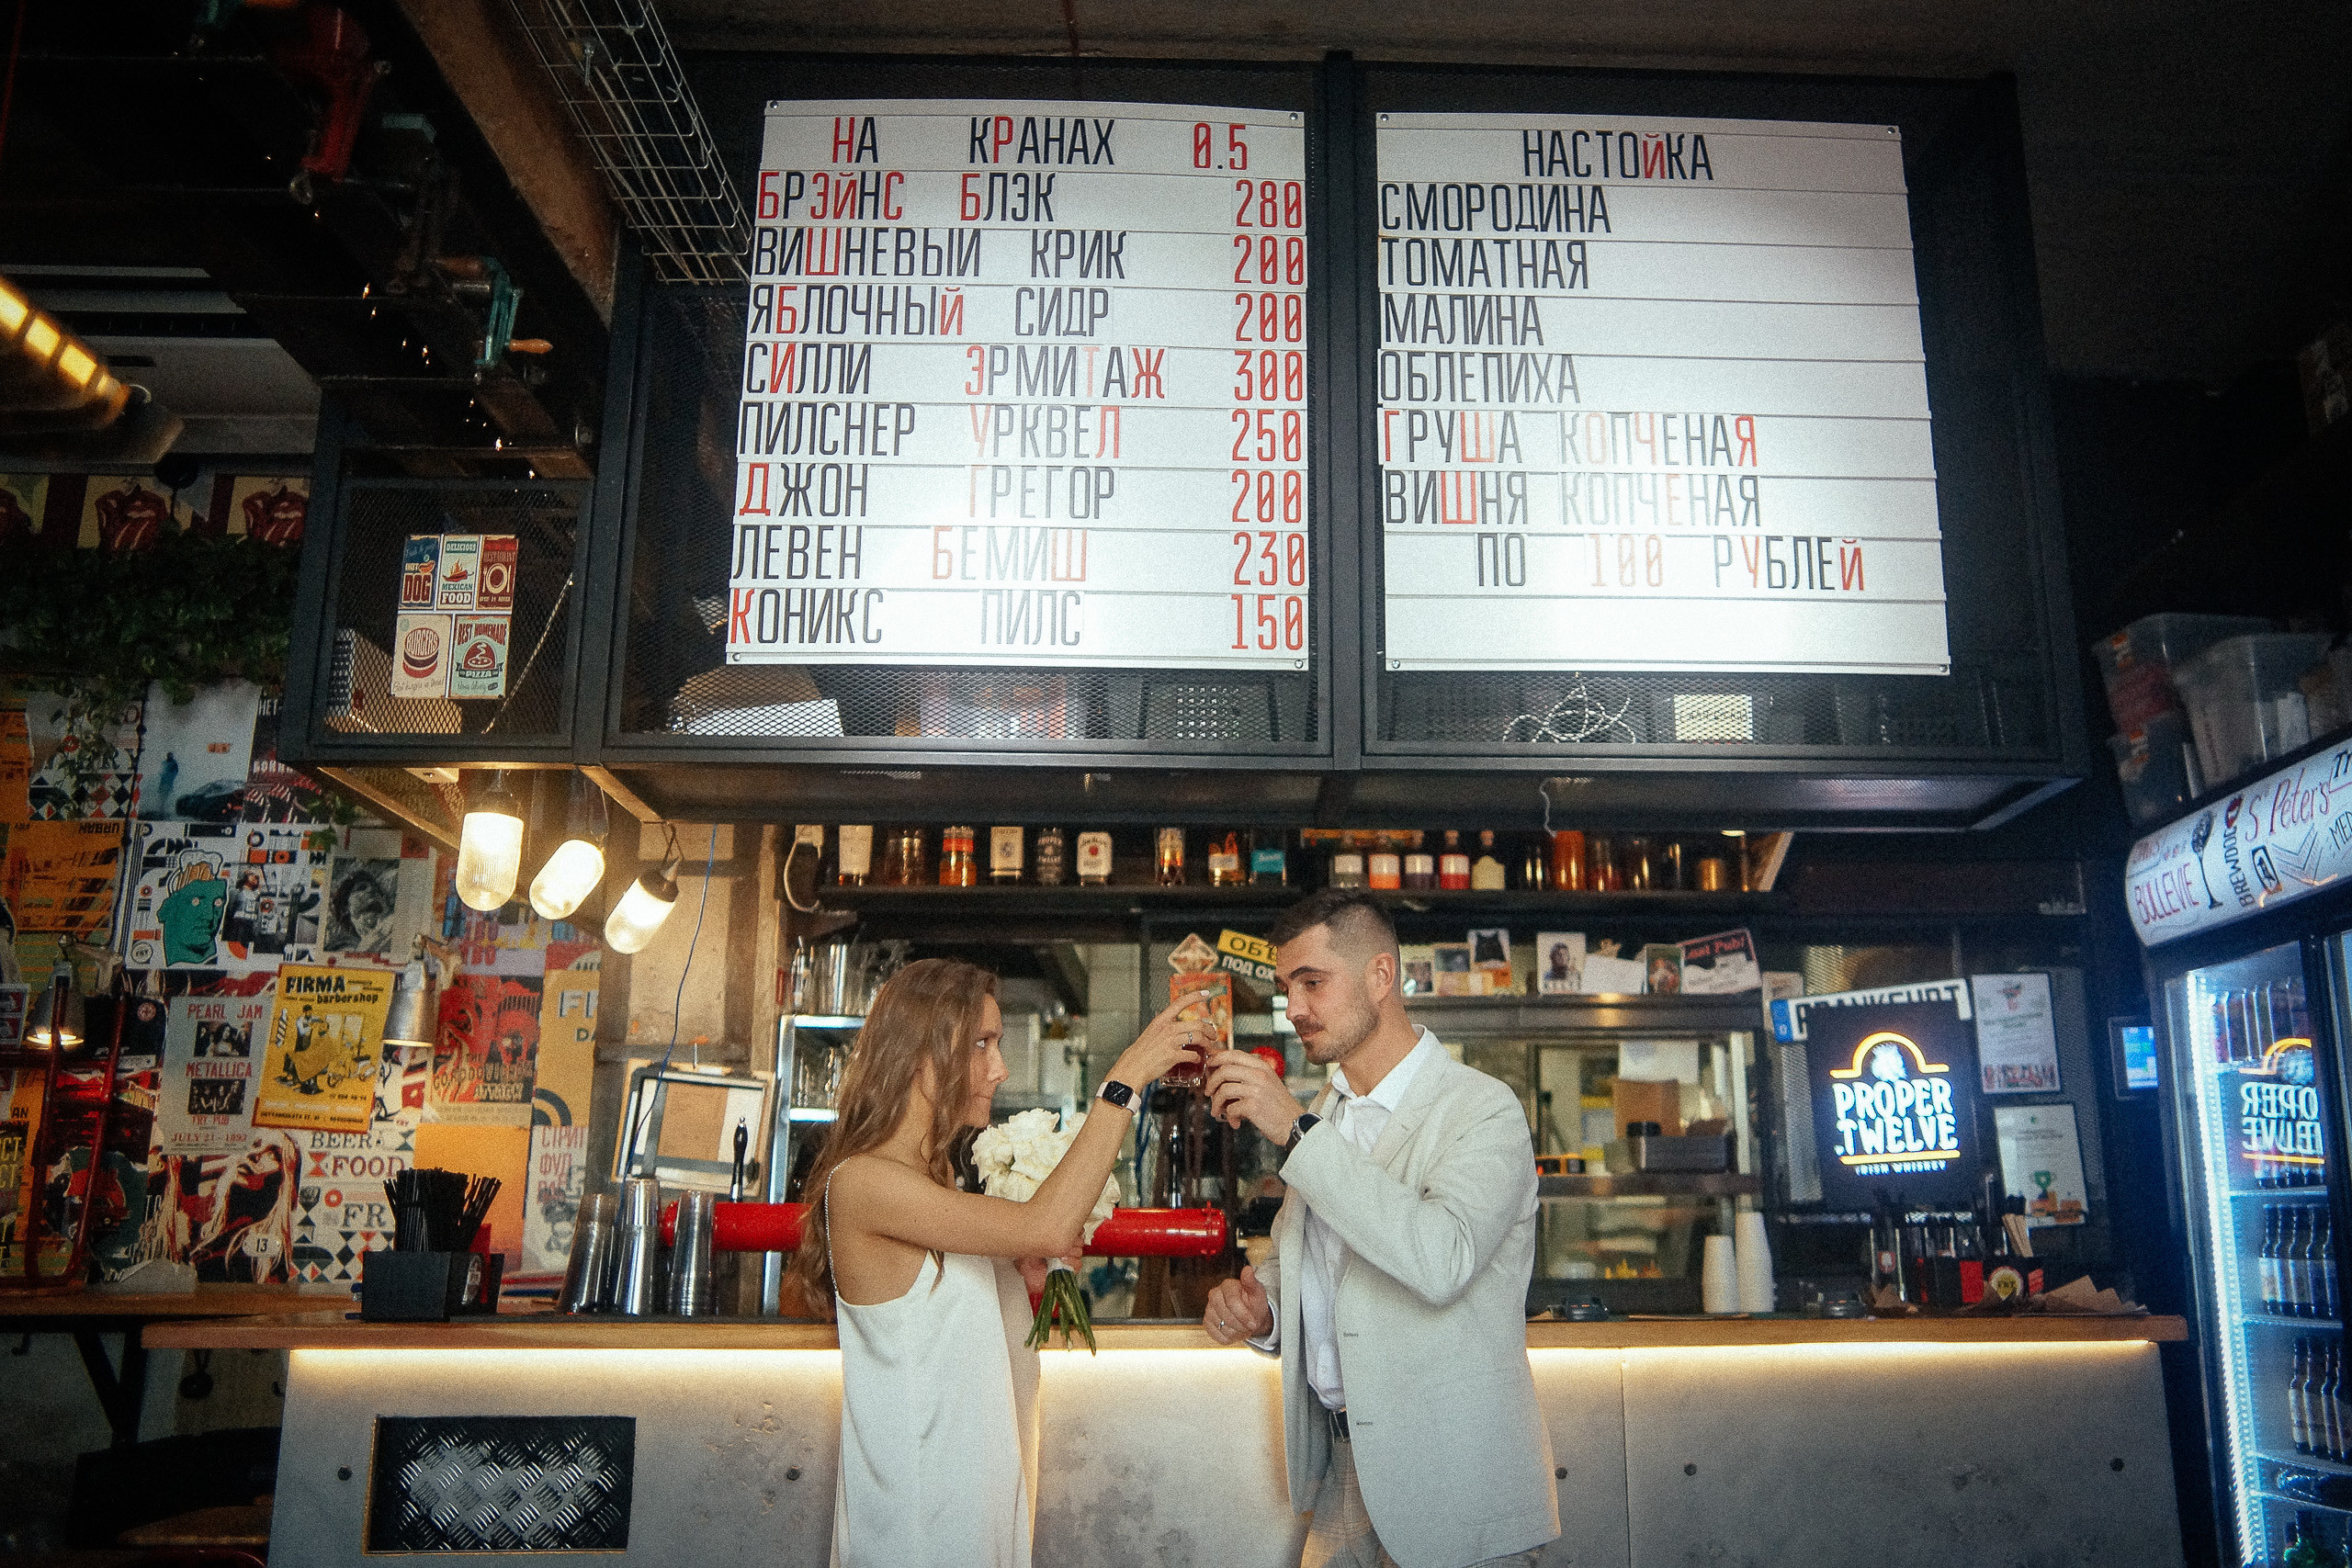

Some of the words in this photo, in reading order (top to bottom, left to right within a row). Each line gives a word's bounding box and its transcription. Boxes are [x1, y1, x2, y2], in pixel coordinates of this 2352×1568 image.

[832, 116, 878, 164] НА
[969, 116, 1115, 165] КРАНАХ
[1193, 122, 1247, 170] 0.5
[1522, 130, 1713, 180] НАСТОЙКА
[757, 171, 903, 220] БРЭЙНС
[960, 172, 1056, 221] БЛЭК
[1235, 180, 1302, 229] 280
[1381, 183, 1611, 234] СМОРОДИНА
[1031, 229, 1126, 278] КРИК
[1234, 235, 1304, 285] 200
[1381, 239, 1589, 289] ТОМАТНАЯ
[750, 284, 964, 336] ЯБЛОЧНЫЙ
[1014, 287, 1109, 337] СИДР
[1235, 292, 1303, 343] 200
[1384, 294, 1544, 346] МАЛИНА
[746, 343, 872, 394] СИЛЛИ
[965, 345, 1166, 399] ЭРМИТАЖ
[1234, 350, 1303, 402] 300
[1380, 350, 1580, 403] ОБЛЕПИХА
[739, 402, 915, 457] ПИЛСНЕР
[969, 404, 1119, 459] УРКВЕЛ
[1231, 409, 1301, 462] 250
[1385, 411, 1521, 464] ГРУША
[1562, 412, 1758, 467] КОПЧЕНАЯ
[740, 463, 866, 517] ДЖОН
[969, 465, 1114, 519] ГРЕГОР
[1231, 469, 1302, 524] 200
[1385, 469, 1528, 525] ВИШНЯ
[1562, 473, 1760, 527] КОПЧЕНАЯ
[447, 542, 477, 552] DELICIOUS
[732, 525, 862, 580] ЛЕВЕН
[933, 526, 1086, 581] БЕМИШ
[1233, 532, 1306, 586] 230
[1477, 534, 1526, 587] ПО
[1589, 534, 1663, 589] 100
[1713, 535, 1864, 592] РУБЛЕЙ
[401, 572, 433, 604] DOG
[442, 592, 471, 604] FOOD
[405, 628, 438, 657] BURGERS
[729, 588, 883, 645] КОНИКС
[981, 590, 1080, 646] ПИЛС
[1231, 594, 1304, 650] 150
[465, 670, 492, 678] PIZZA
[2223, 826, 2256, 908] BREWDOG
[286, 976, 345, 994] FIRMA
[1222, 955, 1254, 976] ПОД
[187, 1003, 226, 1020] PEARL
[237, 1004, 264, 1020] JAM
[317, 993, 379, 1004] barbershop
[186, 1062, 253, 1077] METALLICA
[473, 1082, 524, 1101] ATTACK
[1832, 1077, 1954, 1121] PROPER
[311, 1132, 373, 1148] BEER
[1836, 1112, 1960, 1156] TWELVE
[332, 1156, 405, 1178] FOOD
[255, 1237, 267, 1252] 13
